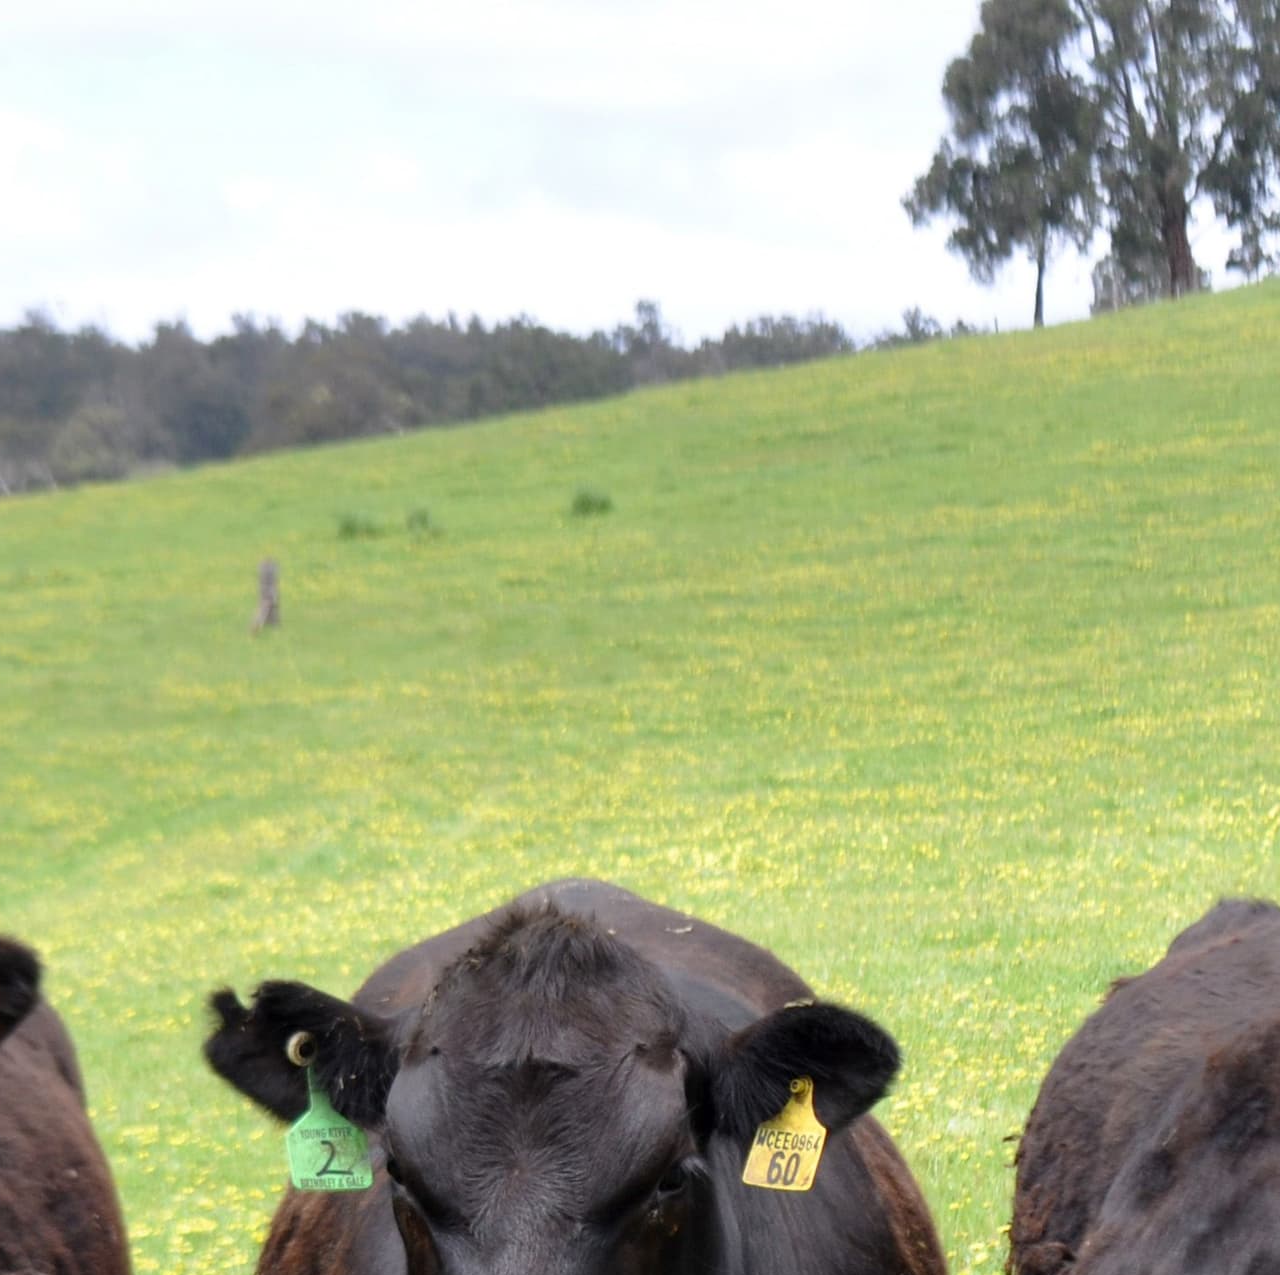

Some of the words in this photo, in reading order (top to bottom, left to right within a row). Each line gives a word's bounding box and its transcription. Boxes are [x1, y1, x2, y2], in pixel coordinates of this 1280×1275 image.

[300, 1128, 328, 1139] YOUNG
[329, 1127, 353, 1138] RIVER
[316, 1140, 354, 1177] 2
[767, 1151, 800, 1186] 60
